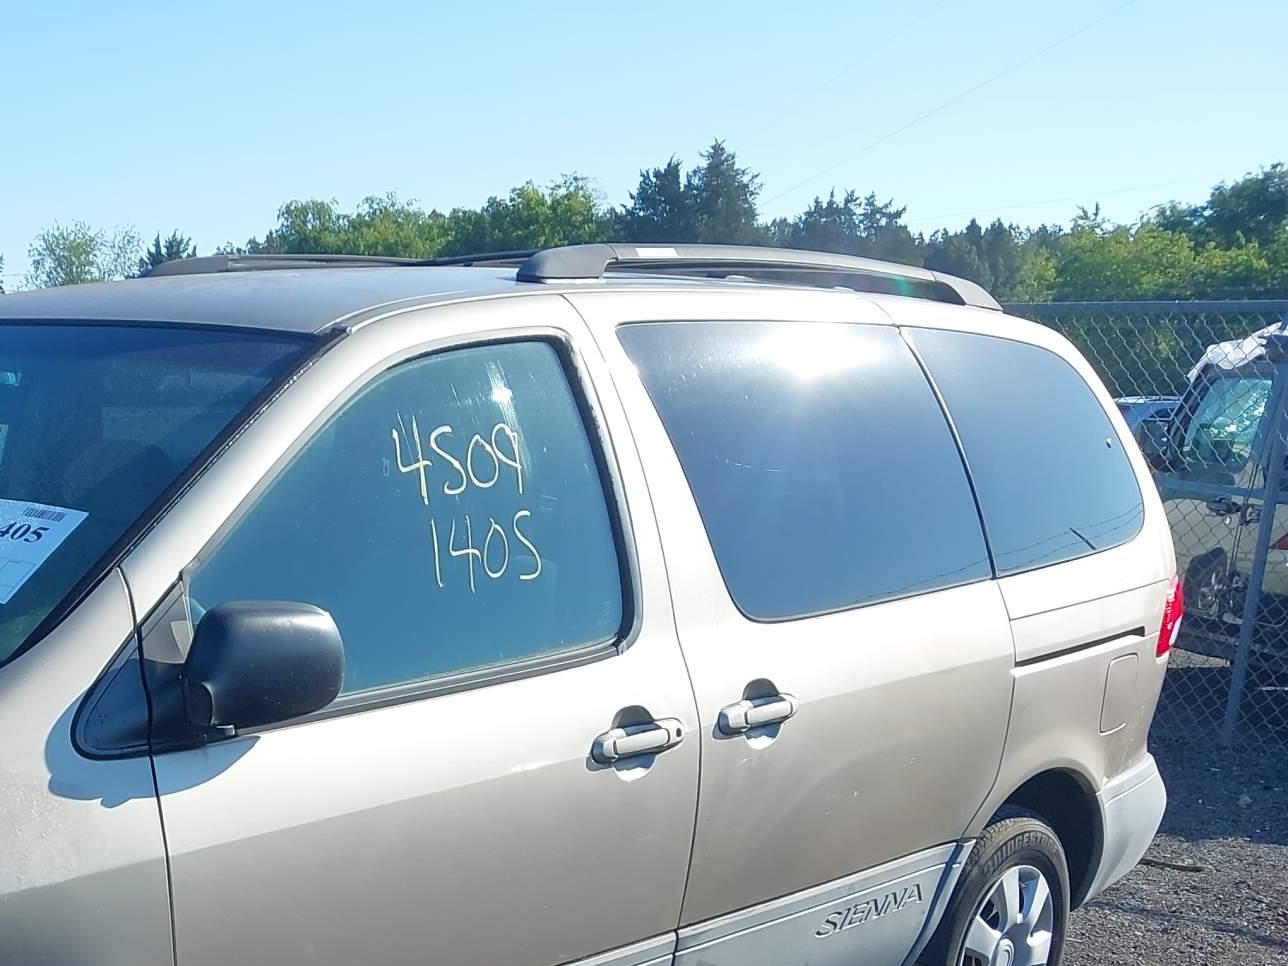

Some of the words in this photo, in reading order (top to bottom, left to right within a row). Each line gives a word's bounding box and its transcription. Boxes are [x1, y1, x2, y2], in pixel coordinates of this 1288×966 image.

[392, 414, 524, 505] 4509
[429, 510, 542, 594] 1405
[815, 883, 924, 938] SIENNA
